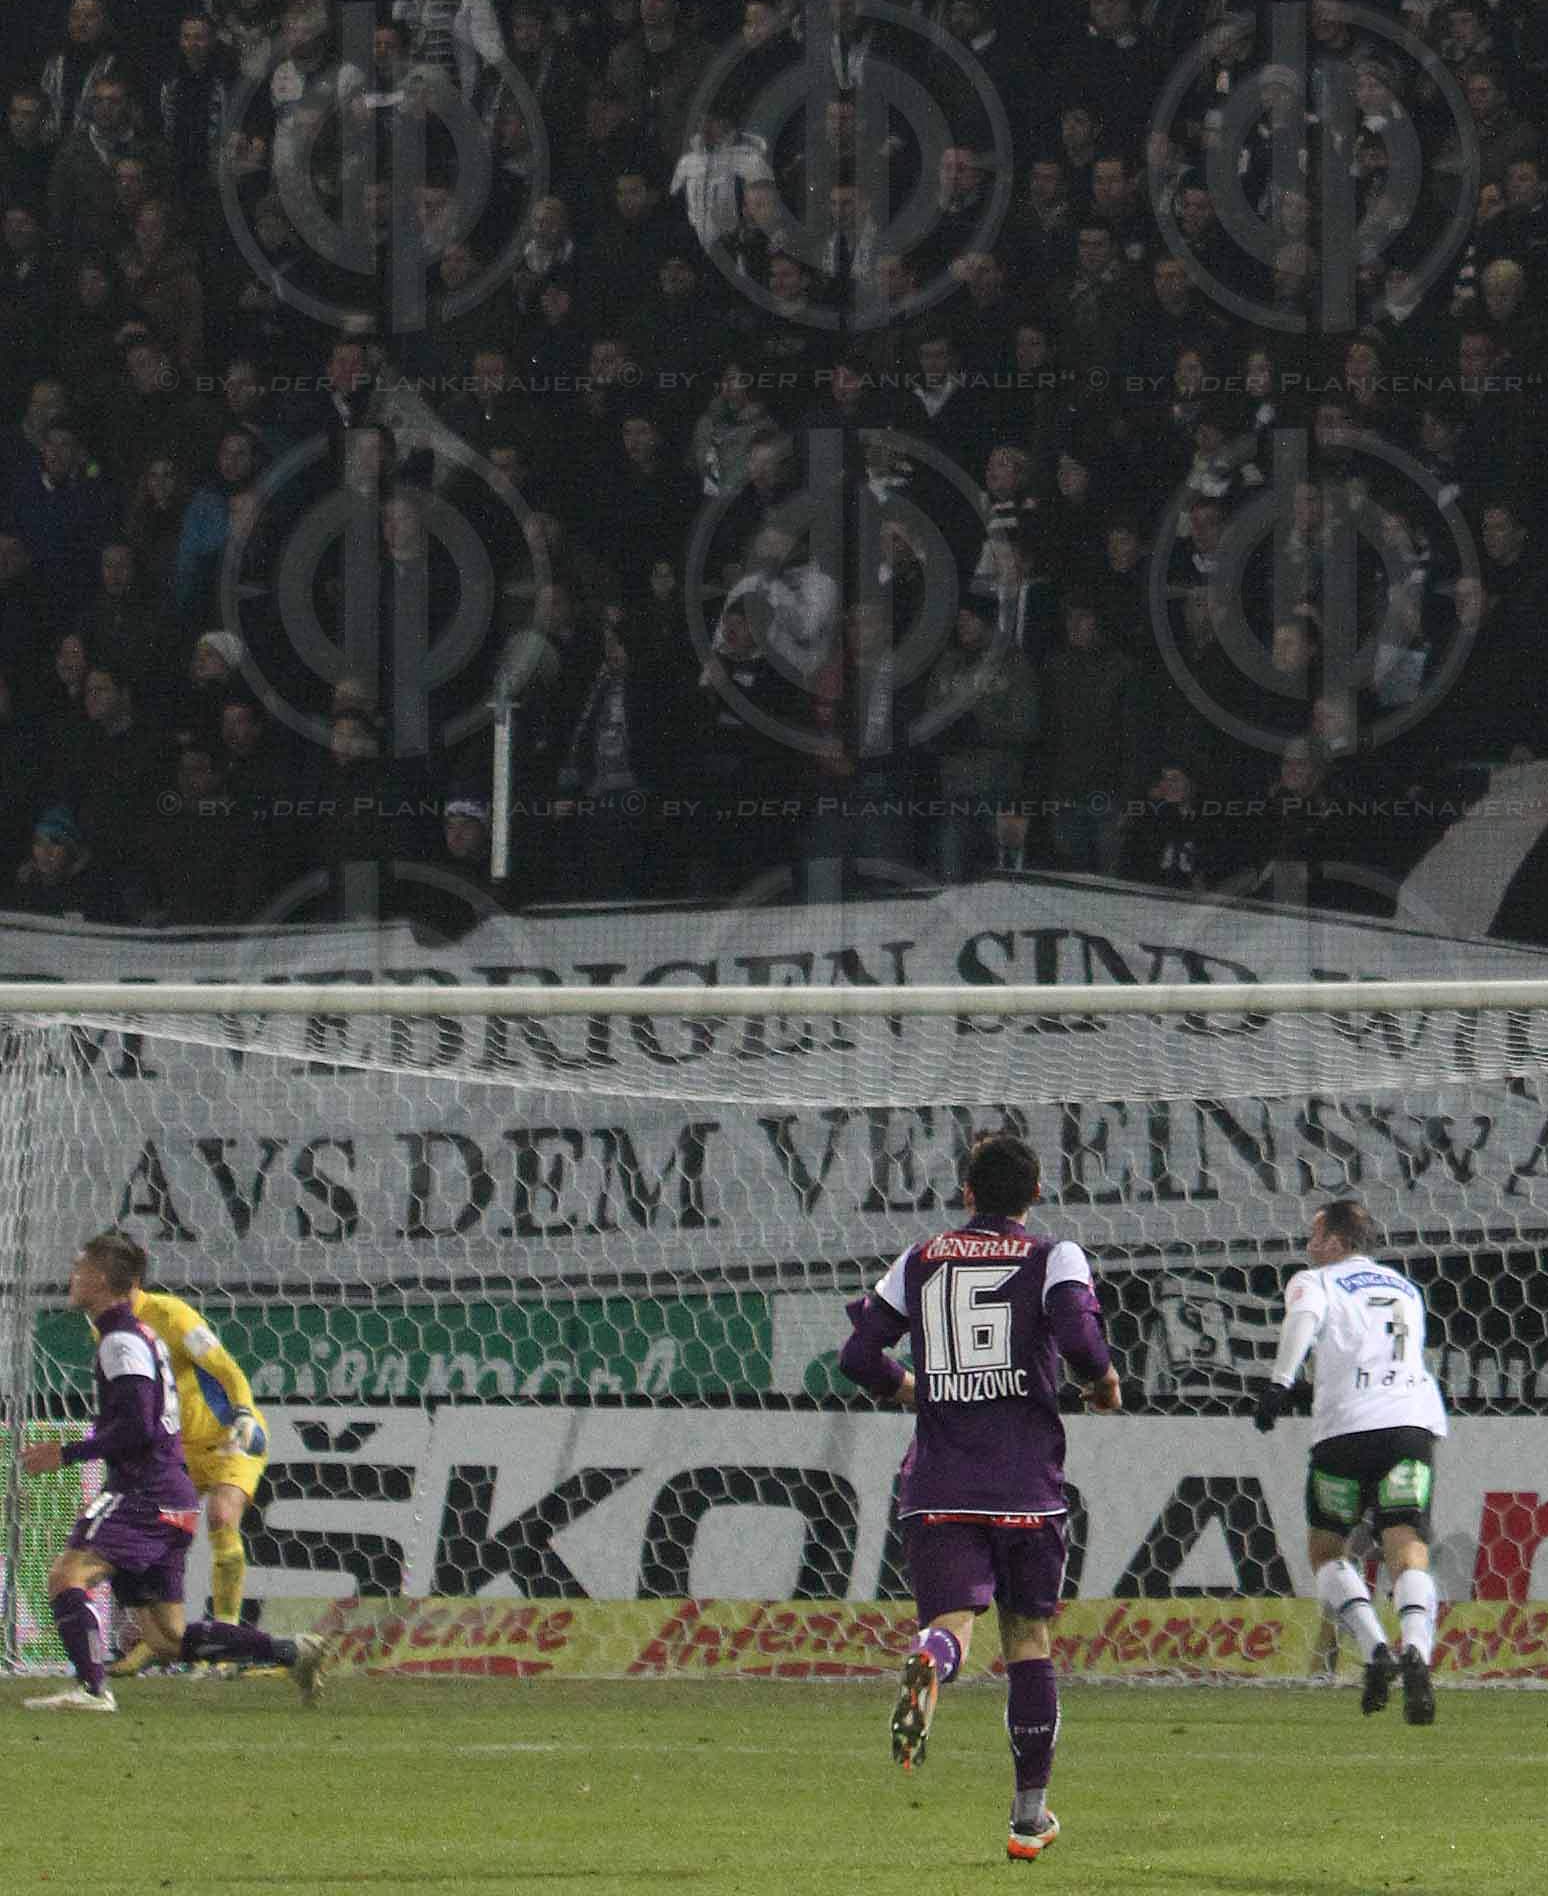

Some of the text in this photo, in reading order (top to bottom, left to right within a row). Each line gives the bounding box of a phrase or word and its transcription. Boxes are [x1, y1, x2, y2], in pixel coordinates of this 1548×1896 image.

[395, 1123, 719, 1239] DEM
[927, 1235, 1032, 1260] GENERALI
[921, 1261, 1022, 1375] 16
[243, 1420, 1293, 1601] ŠKOA
